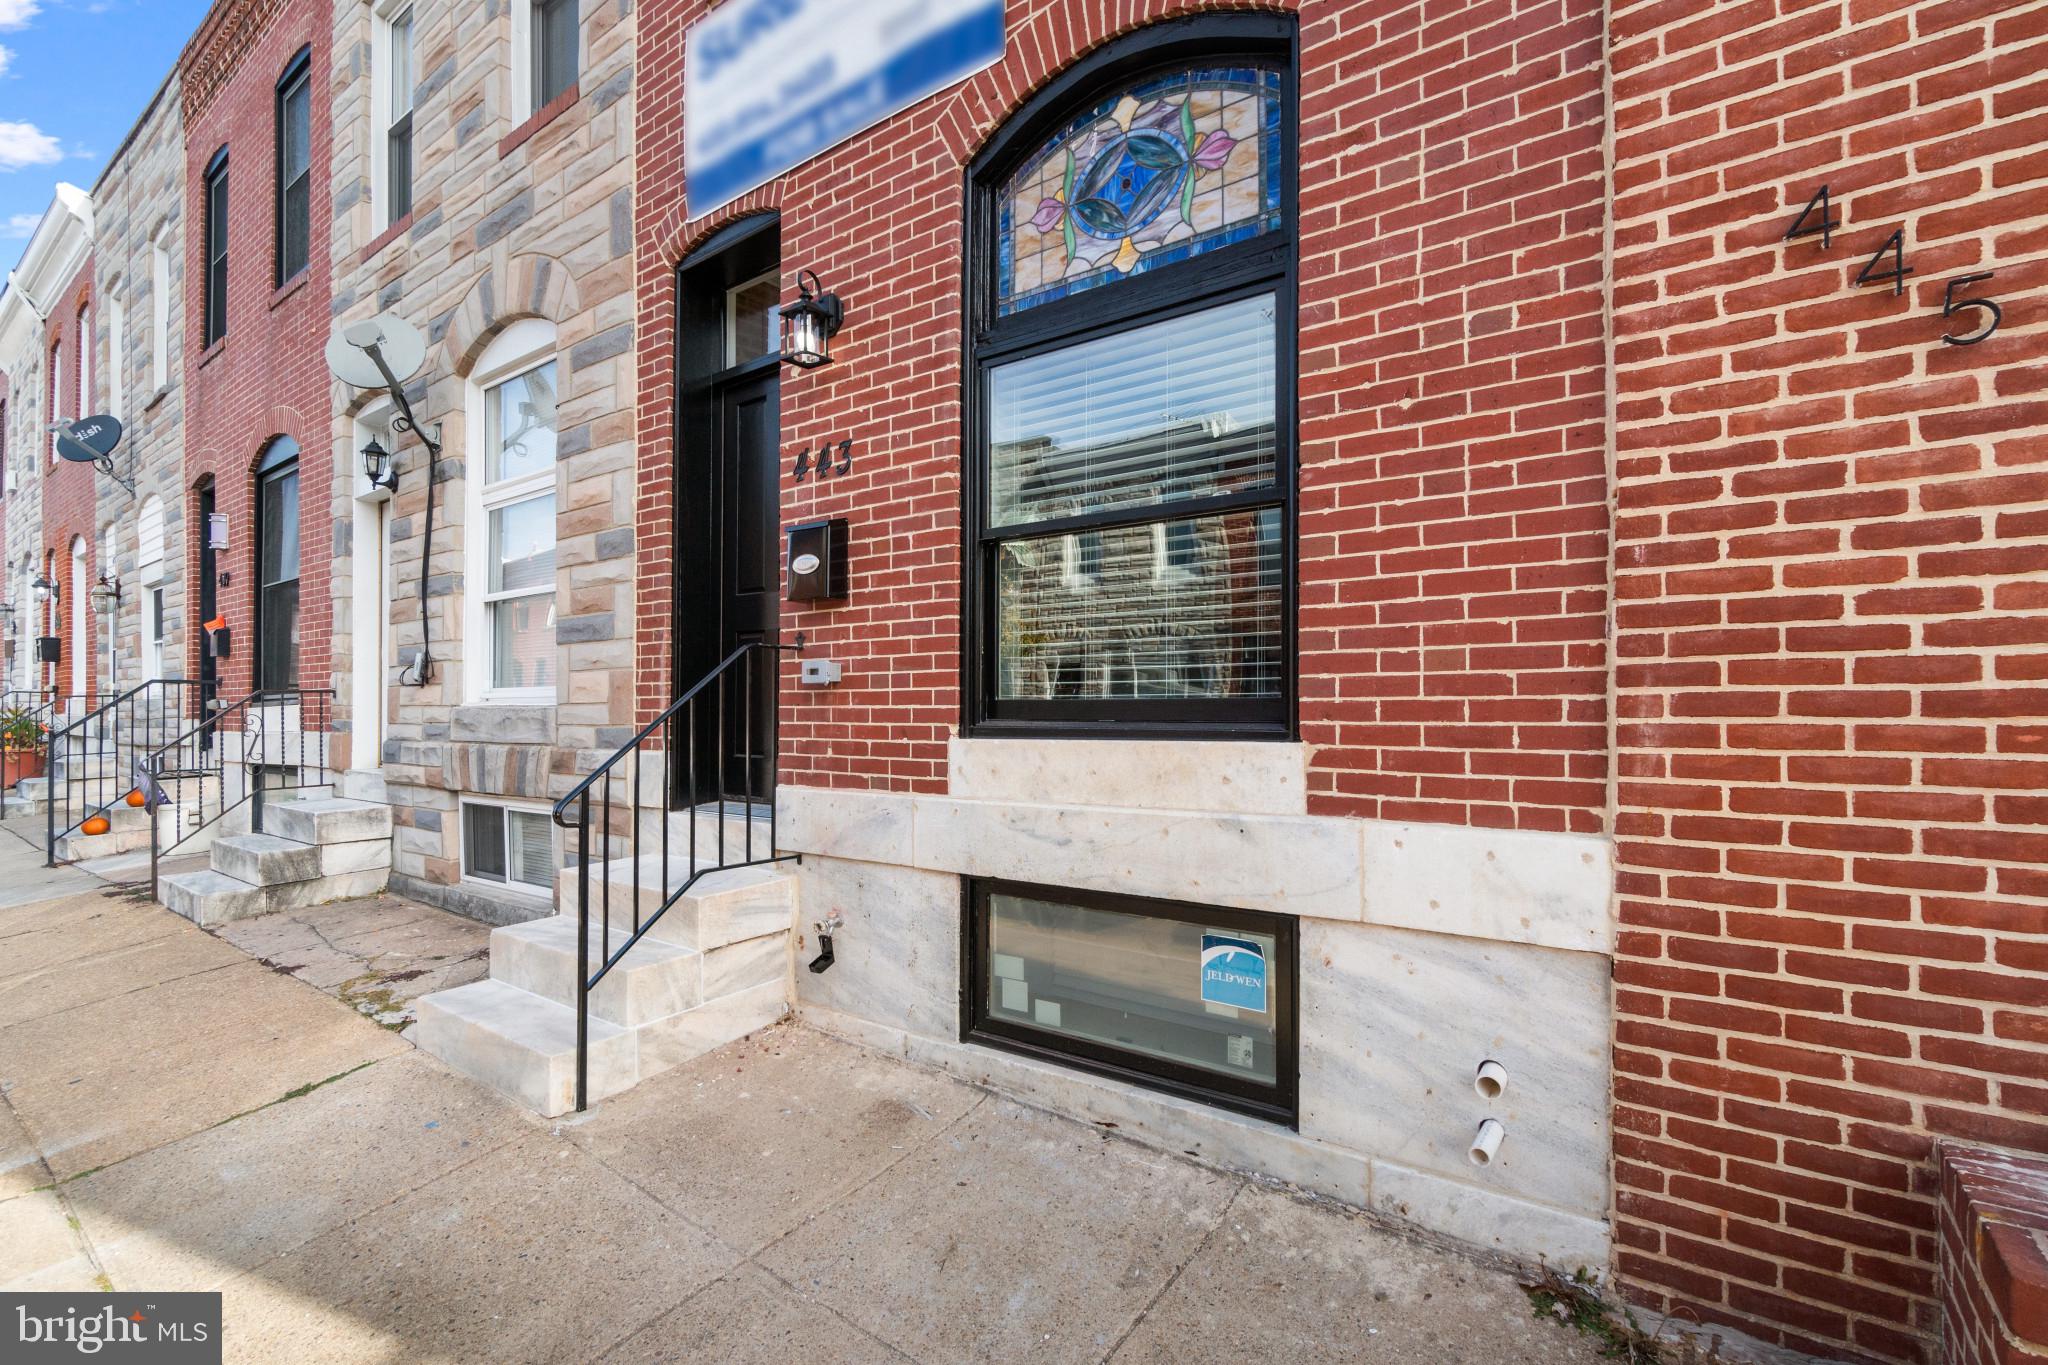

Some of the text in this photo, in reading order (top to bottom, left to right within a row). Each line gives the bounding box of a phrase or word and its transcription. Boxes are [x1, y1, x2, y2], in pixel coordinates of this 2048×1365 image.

[1783, 184, 2001, 346] 445
[793, 438, 853, 483] 443
[1206, 969, 1262, 988] JELD-WEN
